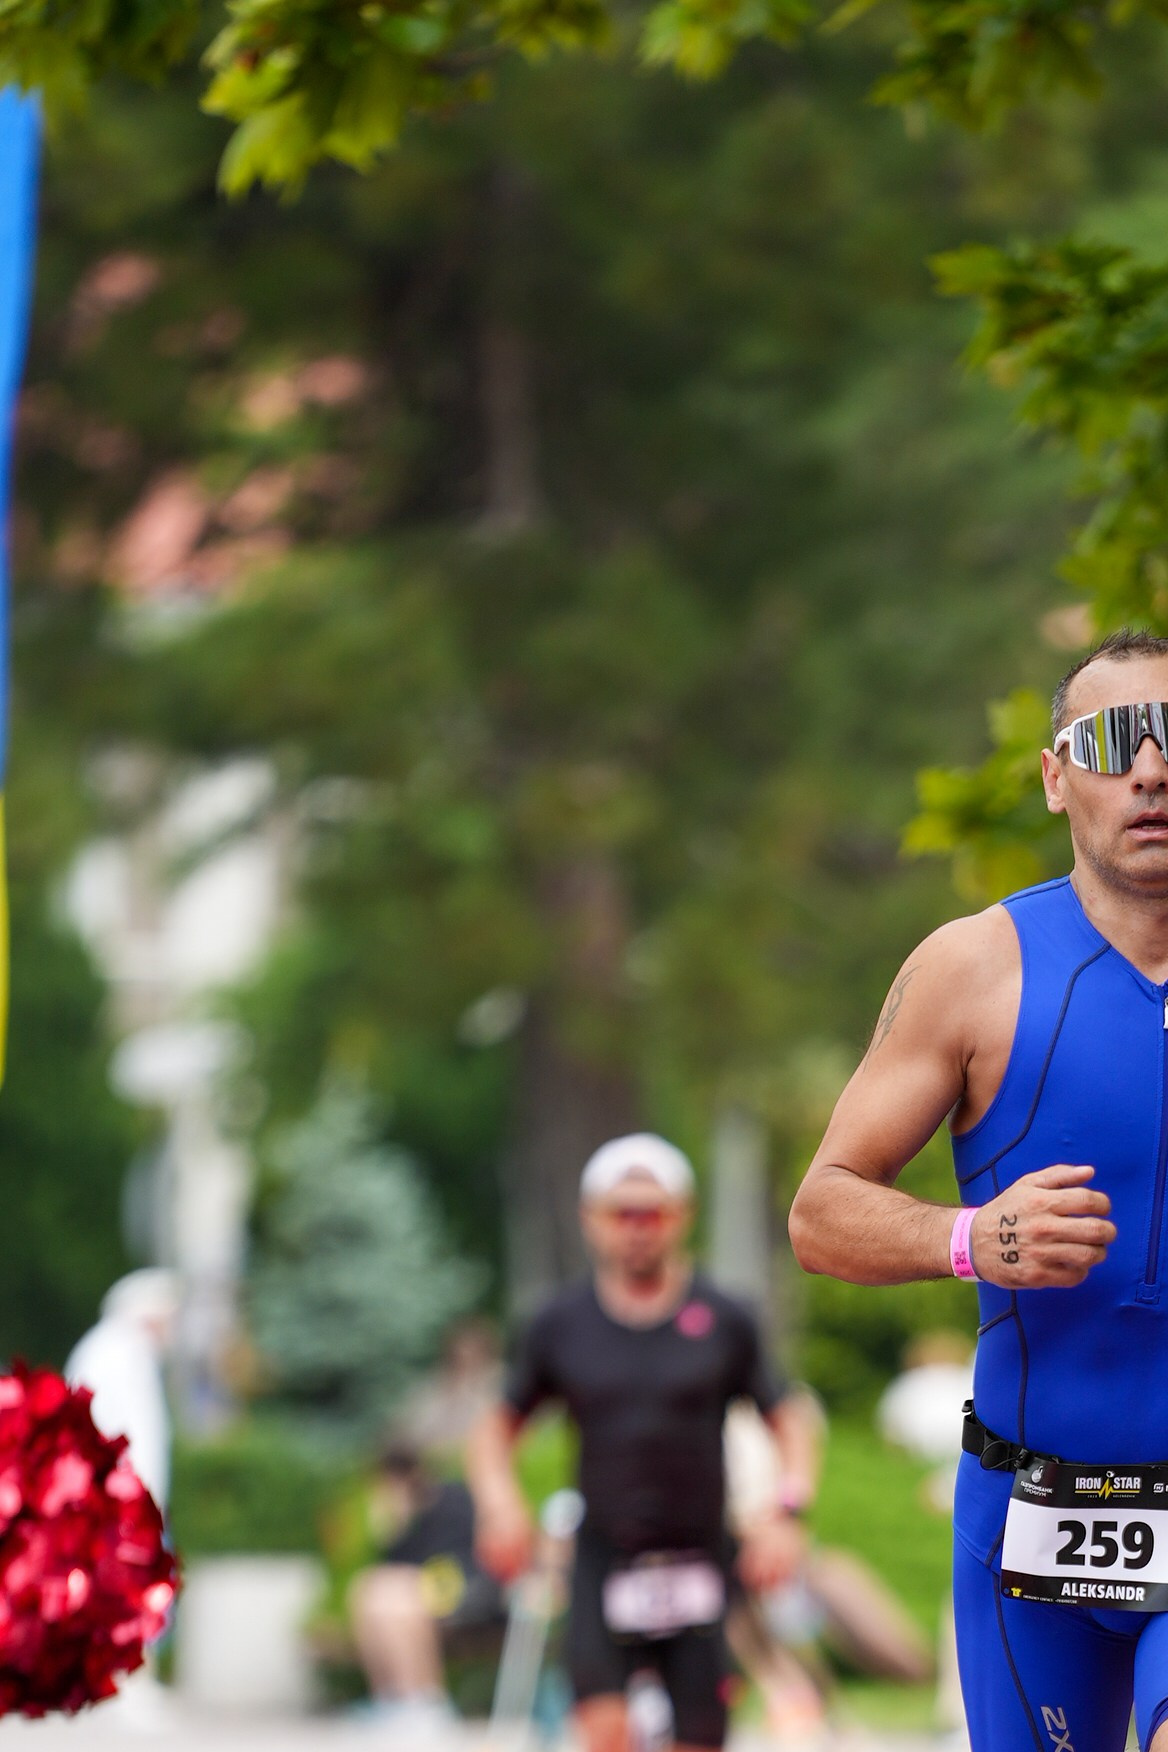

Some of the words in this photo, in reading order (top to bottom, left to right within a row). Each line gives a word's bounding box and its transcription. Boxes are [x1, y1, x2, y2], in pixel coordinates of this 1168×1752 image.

[999, 1214, 1019, 1264] 259
[1075, 1477, 1101, 1489] IRON
[1113, 1476, 1140, 1489] STAR
[1056, 1520, 1154, 1569] 259
[1061, 1582, 1145, 1601] ALEKSANDR
